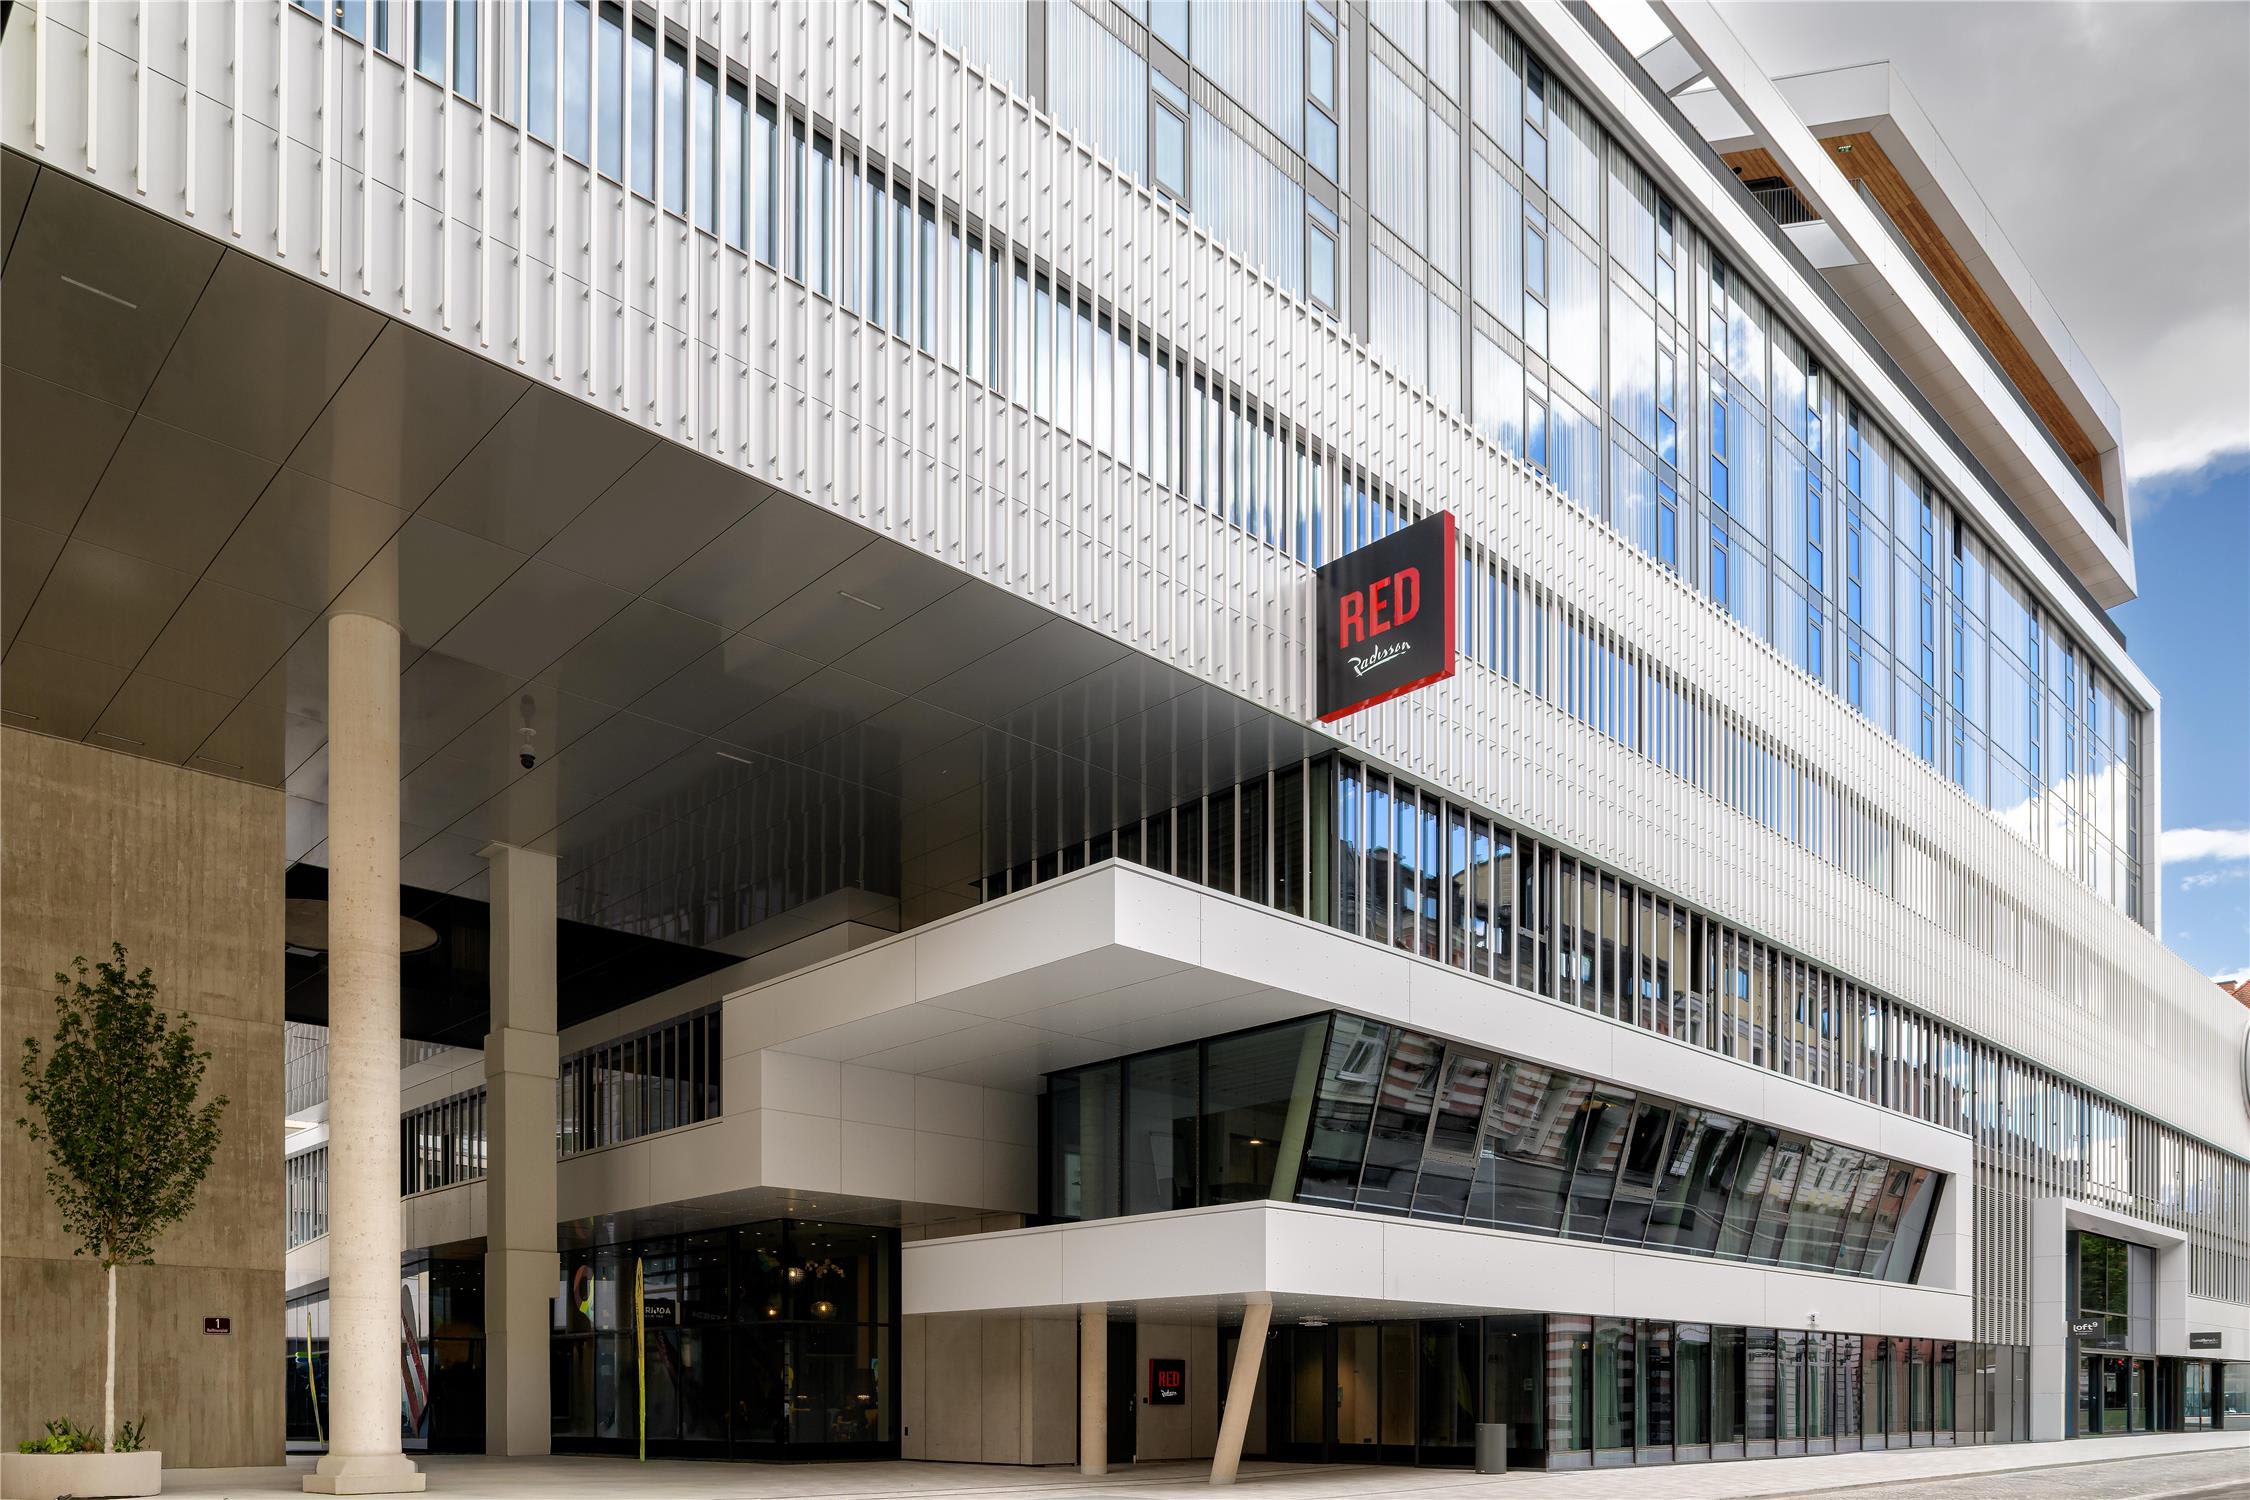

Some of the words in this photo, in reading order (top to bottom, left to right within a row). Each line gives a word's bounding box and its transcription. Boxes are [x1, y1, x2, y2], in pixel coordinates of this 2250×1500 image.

[1339, 567, 1420, 649] RED
[1347, 640, 1411, 677] Radisson
[215, 1318, 220, 1329] 1
[1158, 1371, 1180, 1387] RED
